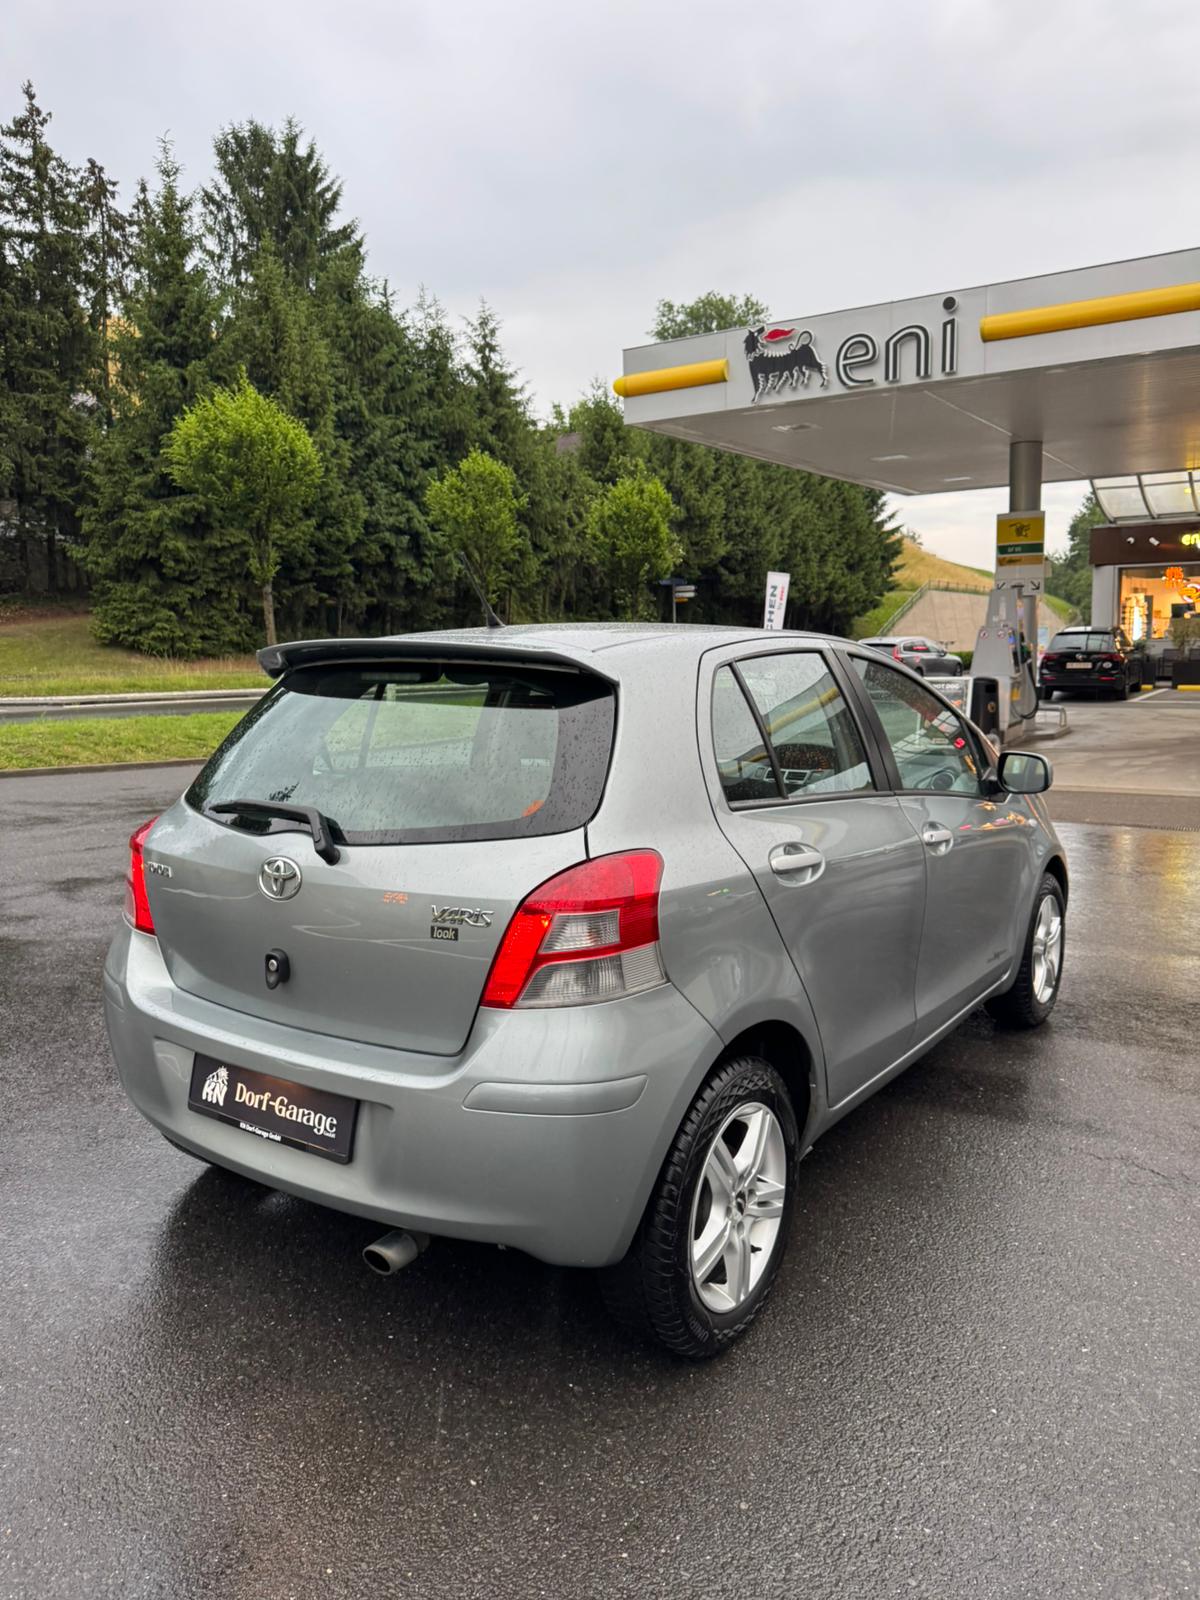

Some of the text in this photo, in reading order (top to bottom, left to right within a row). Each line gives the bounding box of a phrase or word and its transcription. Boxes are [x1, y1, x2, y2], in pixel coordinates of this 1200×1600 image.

[836, 296, 957, 388] eni
[432, 927, 456, 939] look
[235, 1082, 337, 1135] Dorf-Garage
